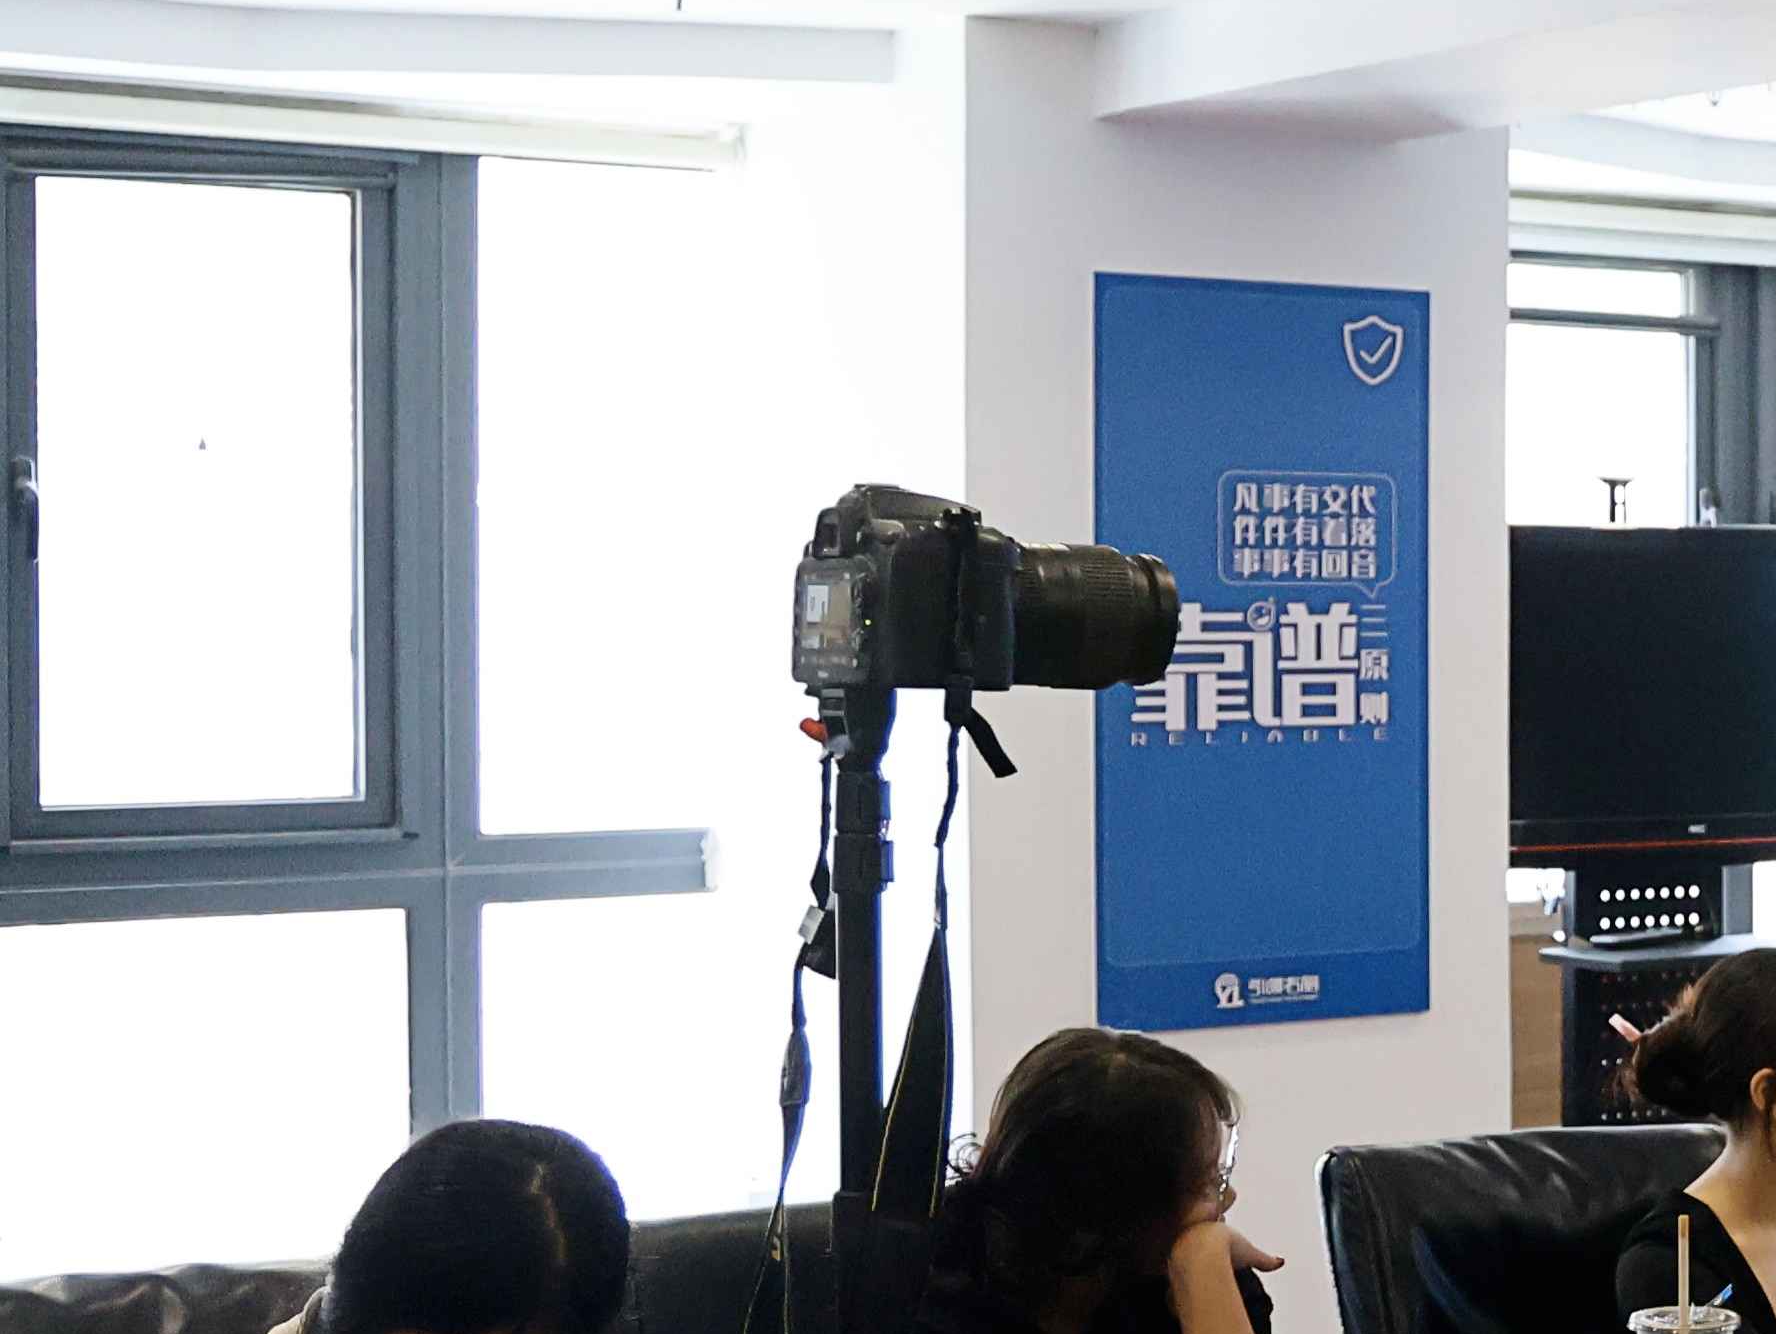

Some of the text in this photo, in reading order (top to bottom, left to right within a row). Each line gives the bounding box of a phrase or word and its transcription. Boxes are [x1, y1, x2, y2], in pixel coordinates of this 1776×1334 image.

[1233, 482, 1376, 514] 凡事有交代
[1233, 548, 1376, 579] 事事有回音
[1131, 597, 1359, 730] 靠谱
